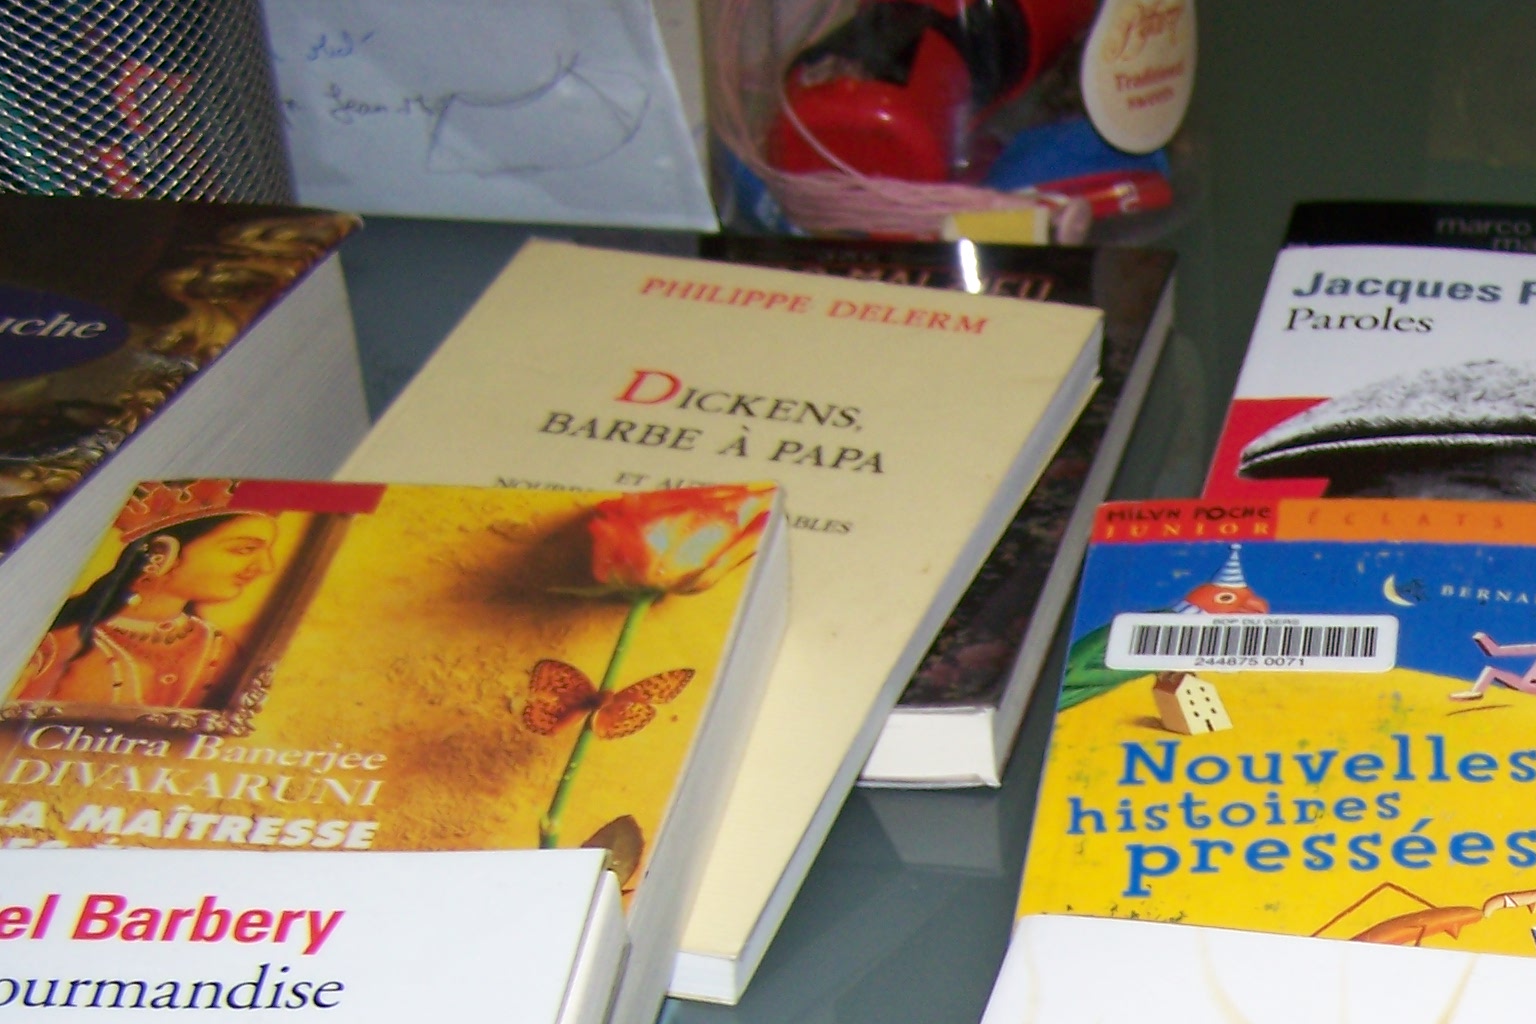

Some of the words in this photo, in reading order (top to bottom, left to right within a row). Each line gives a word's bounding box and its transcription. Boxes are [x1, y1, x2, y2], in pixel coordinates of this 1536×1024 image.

[1436, 218, 1531, 236] marco
[640, 276, 813, 313] PHILIPPE
[827, 298, 988, 335] DELERM
[1292, 271, 1502, 304] Jacques
[1283, 306, 1435, 334] Paroles
[615, 368, 864, 432] DICKENS,
[538, 410, 703, 452] BARBE
[718, 425, 750, 456] À
[768, 439, 886, 474] PAPA
[615, 471, 646, 487] ET
[1105, 522, 1270, 539] JUNIOR
[1194, 657, 1259, 667] 244875
[1264, 657, 1305, 667] 0071
[25, 723, 171, 758] Chitra
[185, 732, 388, 772] Banerjee
[5, 757, 385, 807] DIVAKARUNI
[69, 804, 379, 849] MAÎTRESSE
[1066, 790, 1402, 834] histoires
[72, 893, 344, 956] Barbery
